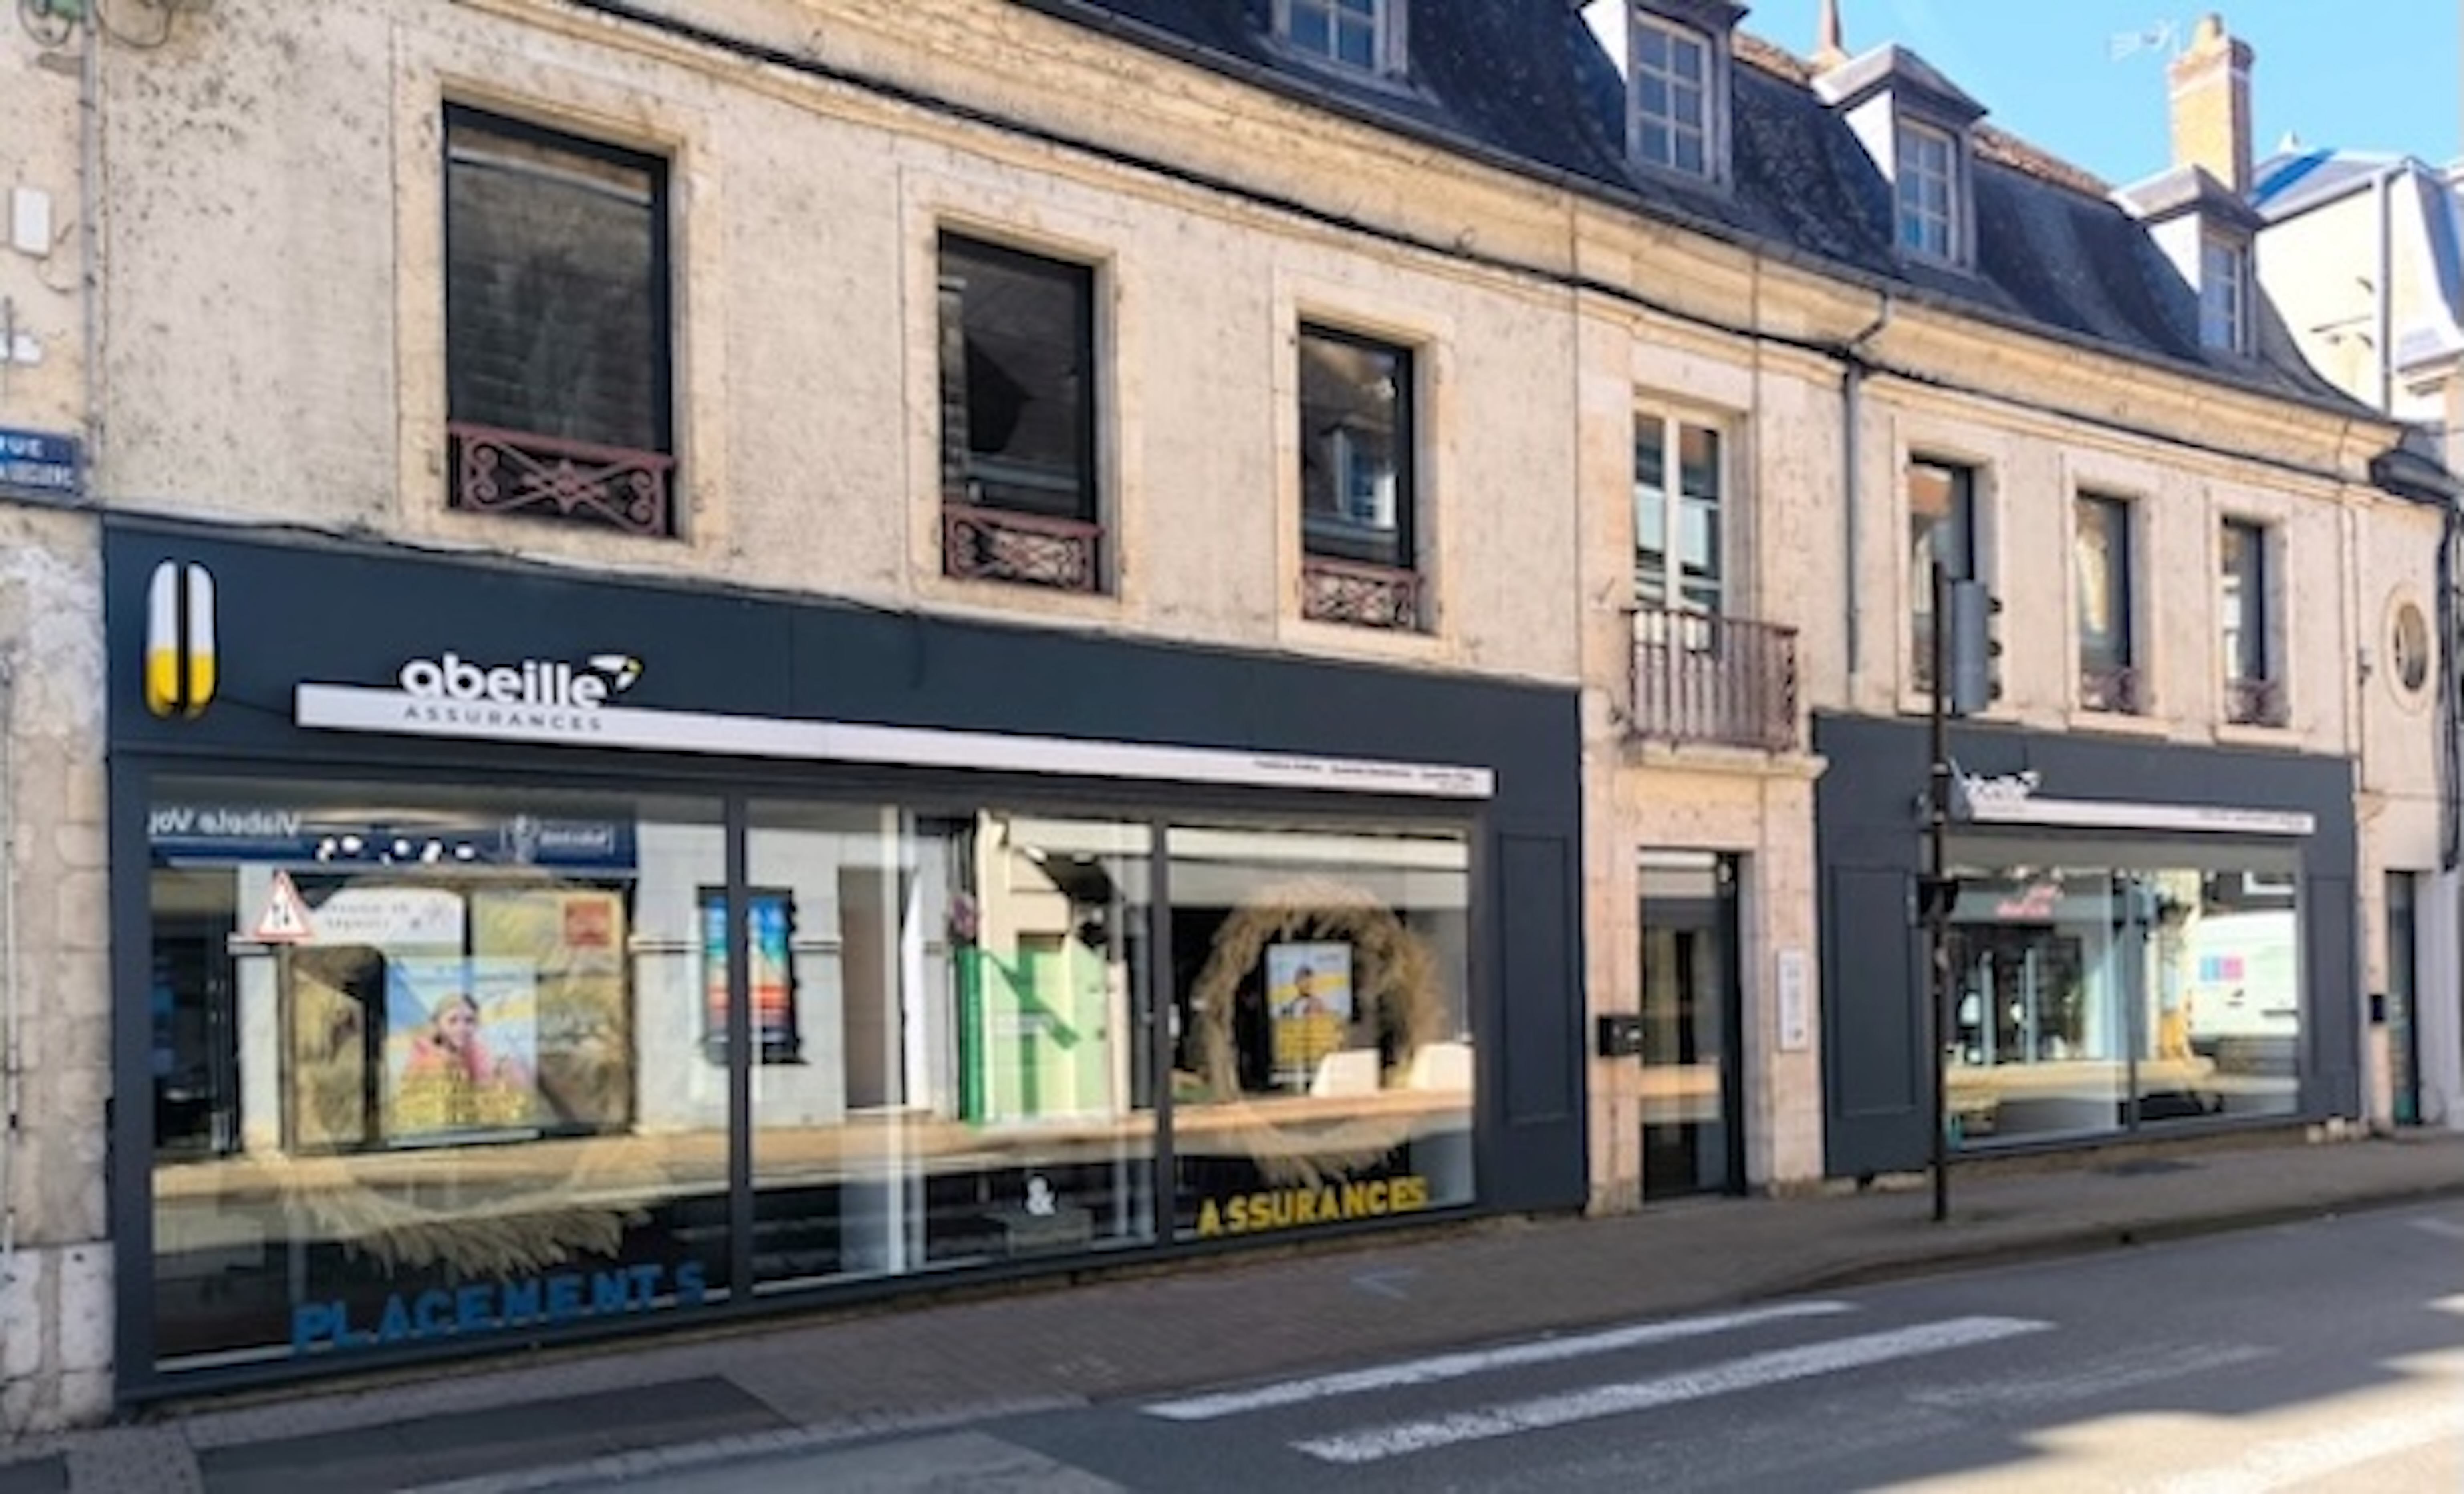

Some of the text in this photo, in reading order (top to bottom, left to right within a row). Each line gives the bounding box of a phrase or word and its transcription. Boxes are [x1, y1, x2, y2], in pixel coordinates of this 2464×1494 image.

[401, 652, 607, 710] abeille
[404, 705, 602, 731] ASSURANCES
[1027, 1176, 1055, 1216] &
[1198, 1176, 1427, 1238] ASSURANCES
[292, 1260, 706, 1352] PLACEMENTS
